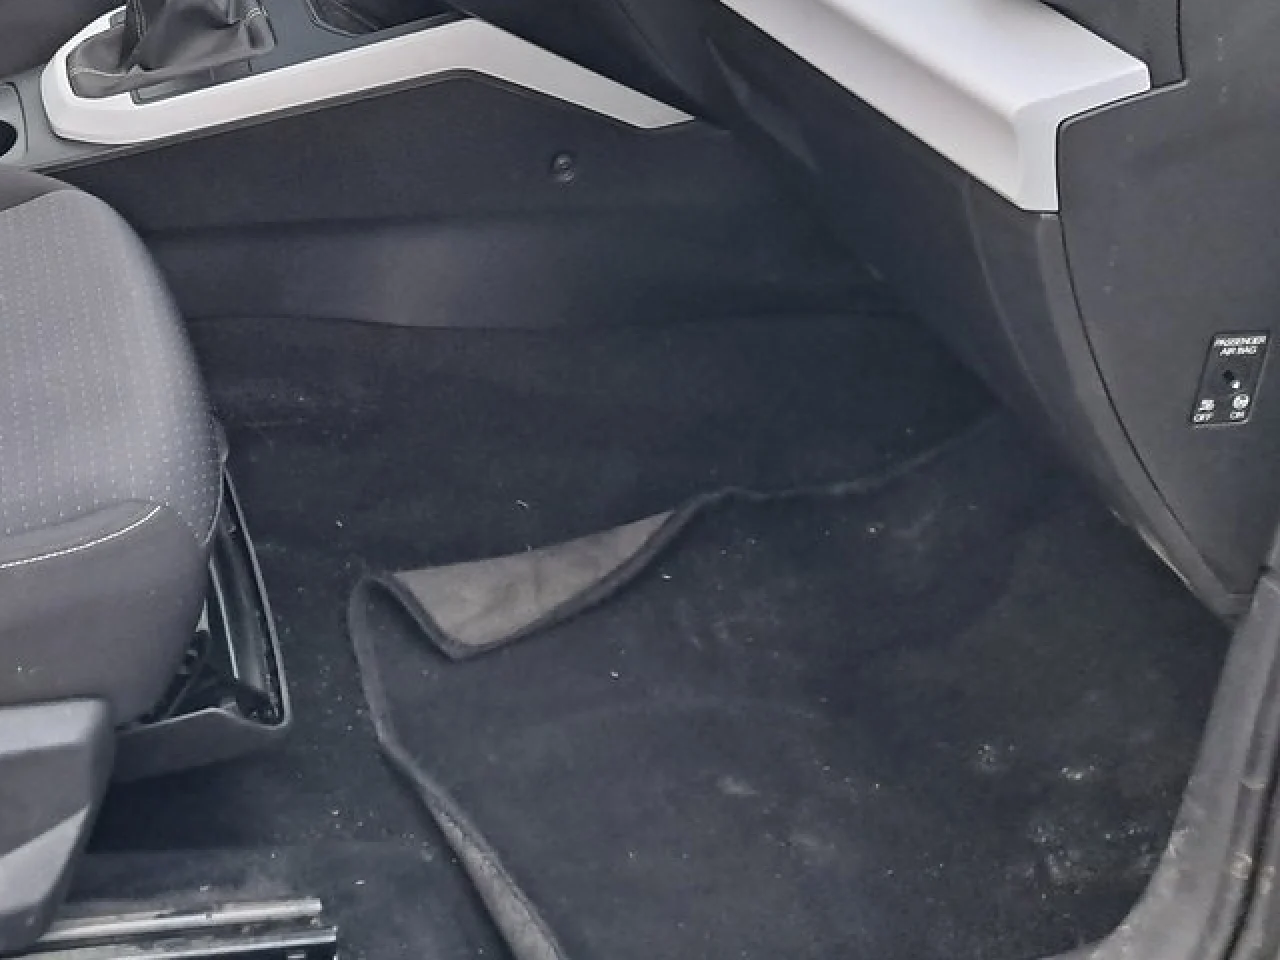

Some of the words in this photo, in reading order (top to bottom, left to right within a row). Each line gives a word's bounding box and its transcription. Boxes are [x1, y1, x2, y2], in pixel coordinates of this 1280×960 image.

[1214, 335, 1266, 346] PASSENGER
[1194, 413, 1214, 422] OFF
[1229, 411, 1245, 420] ON
